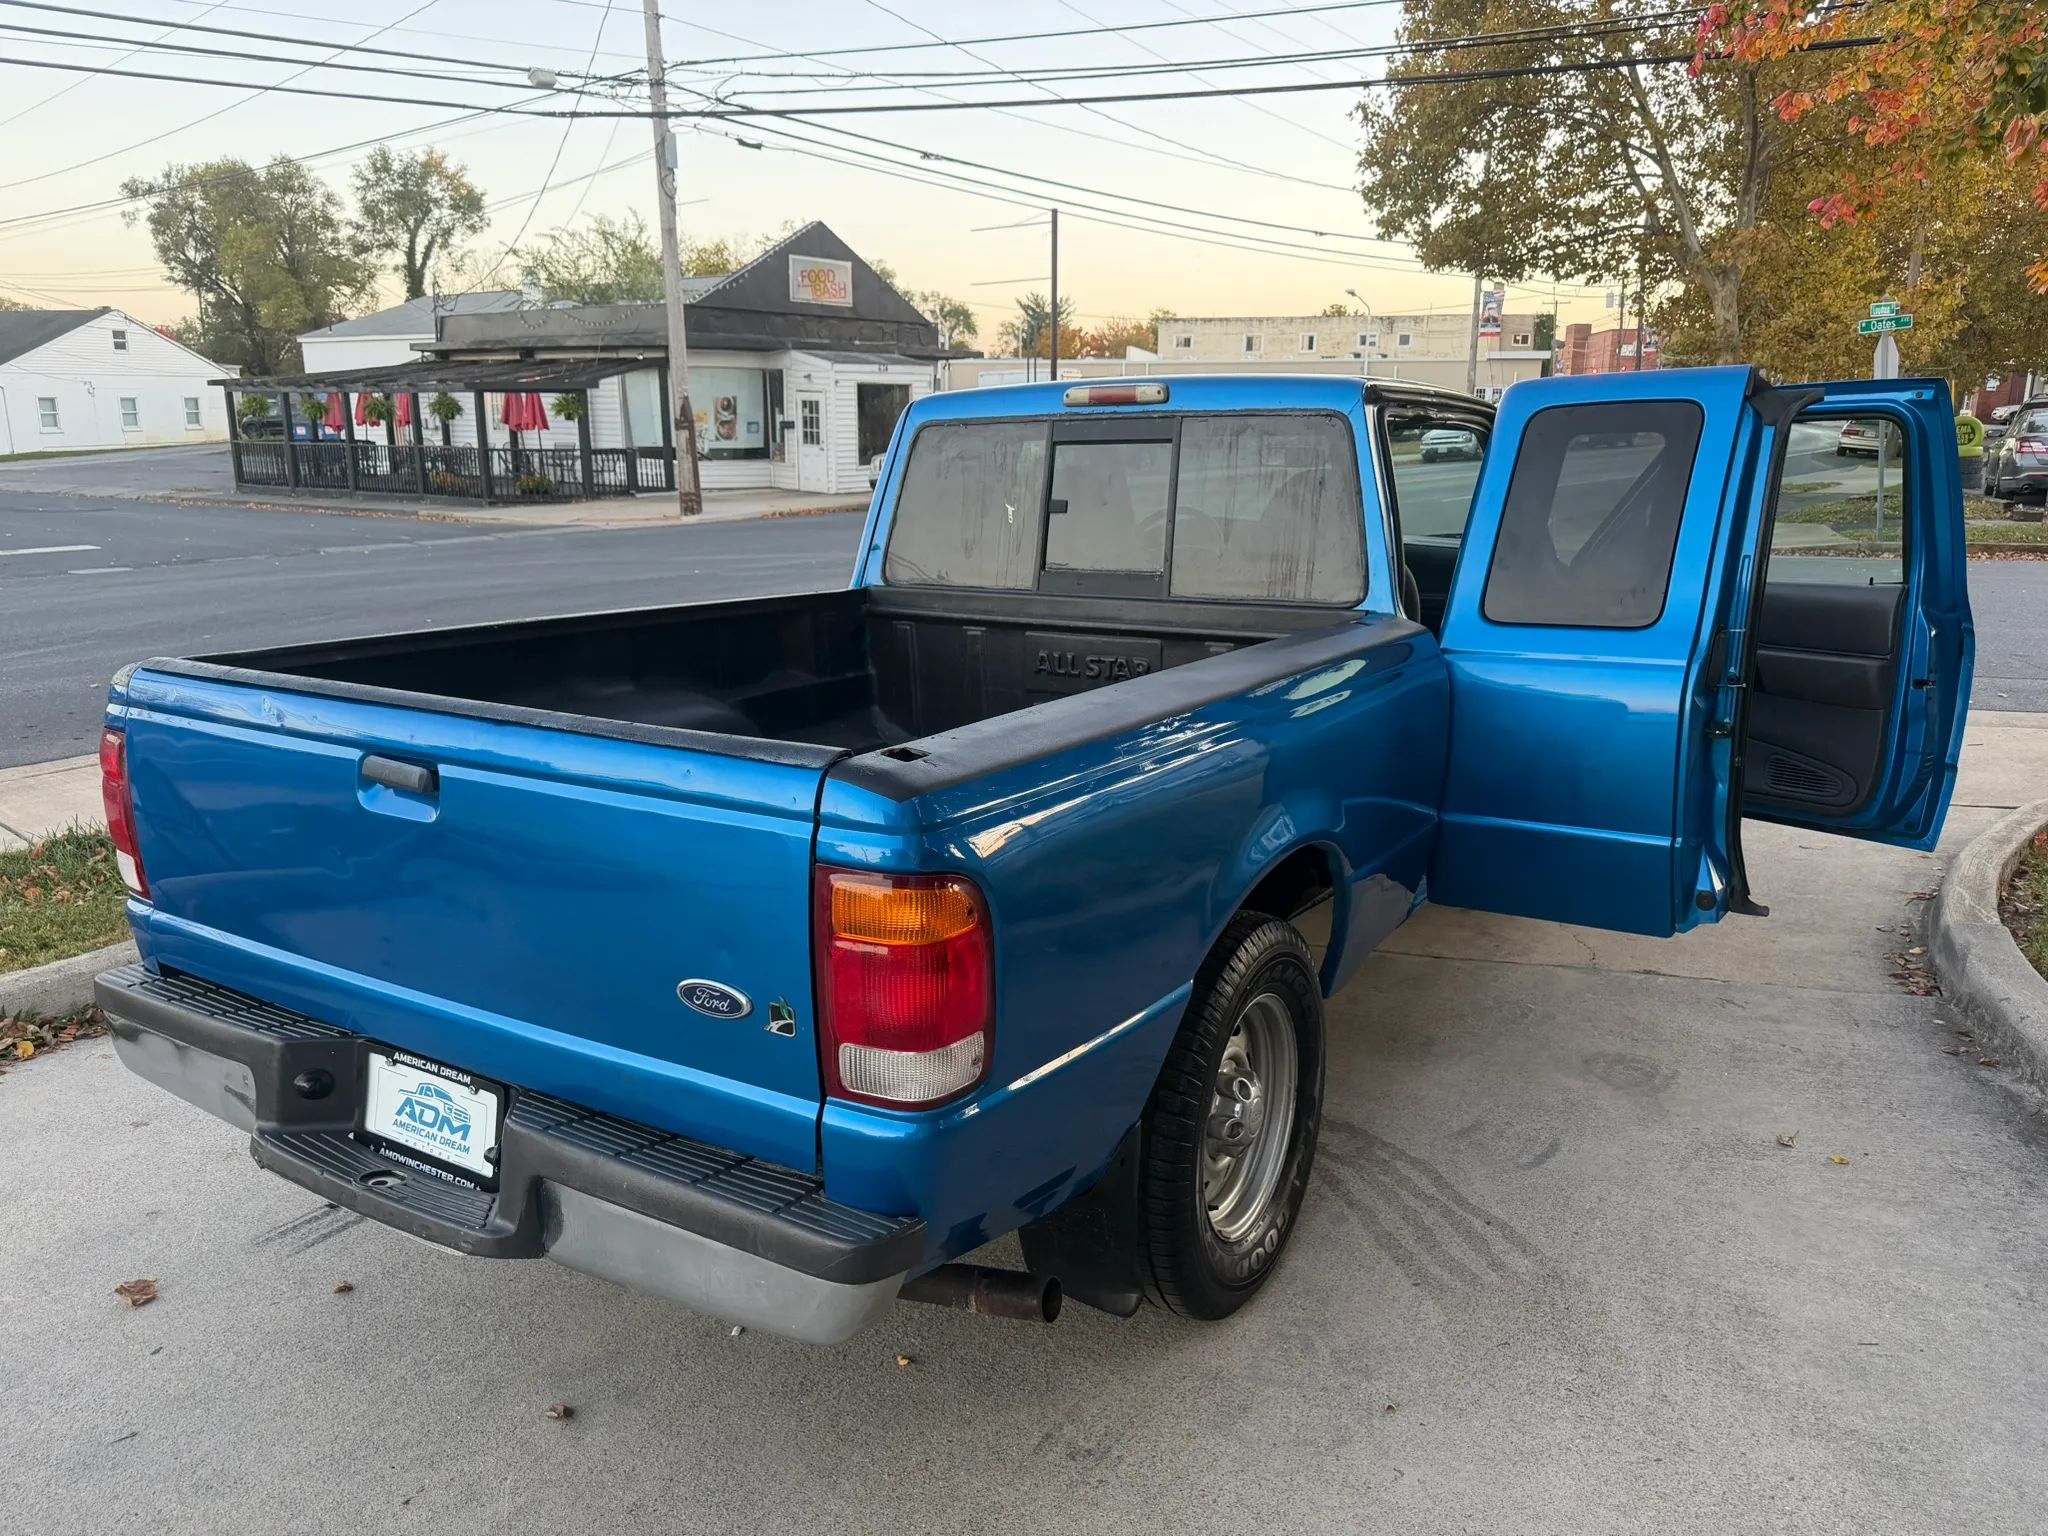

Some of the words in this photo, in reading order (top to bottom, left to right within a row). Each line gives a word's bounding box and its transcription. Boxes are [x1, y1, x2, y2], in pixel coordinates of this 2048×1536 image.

[800, 269, 836, 284] FOOD
[813, 282, 847, 298] BASH
[1870, 320, 1896, 331] Oates
[1035, 650, 1080, 676] ALL
[693, 987, 730, 1012] Ford
[393, 1052, 439, 1073] AMERICAN
[440, 1067, 471, 1085] DREAM
[395, 1096, 472, 1142] ADM
[392, 1118, 438, 1144] AMERICAN
[439, 1136, 471, 1155] DREAM
